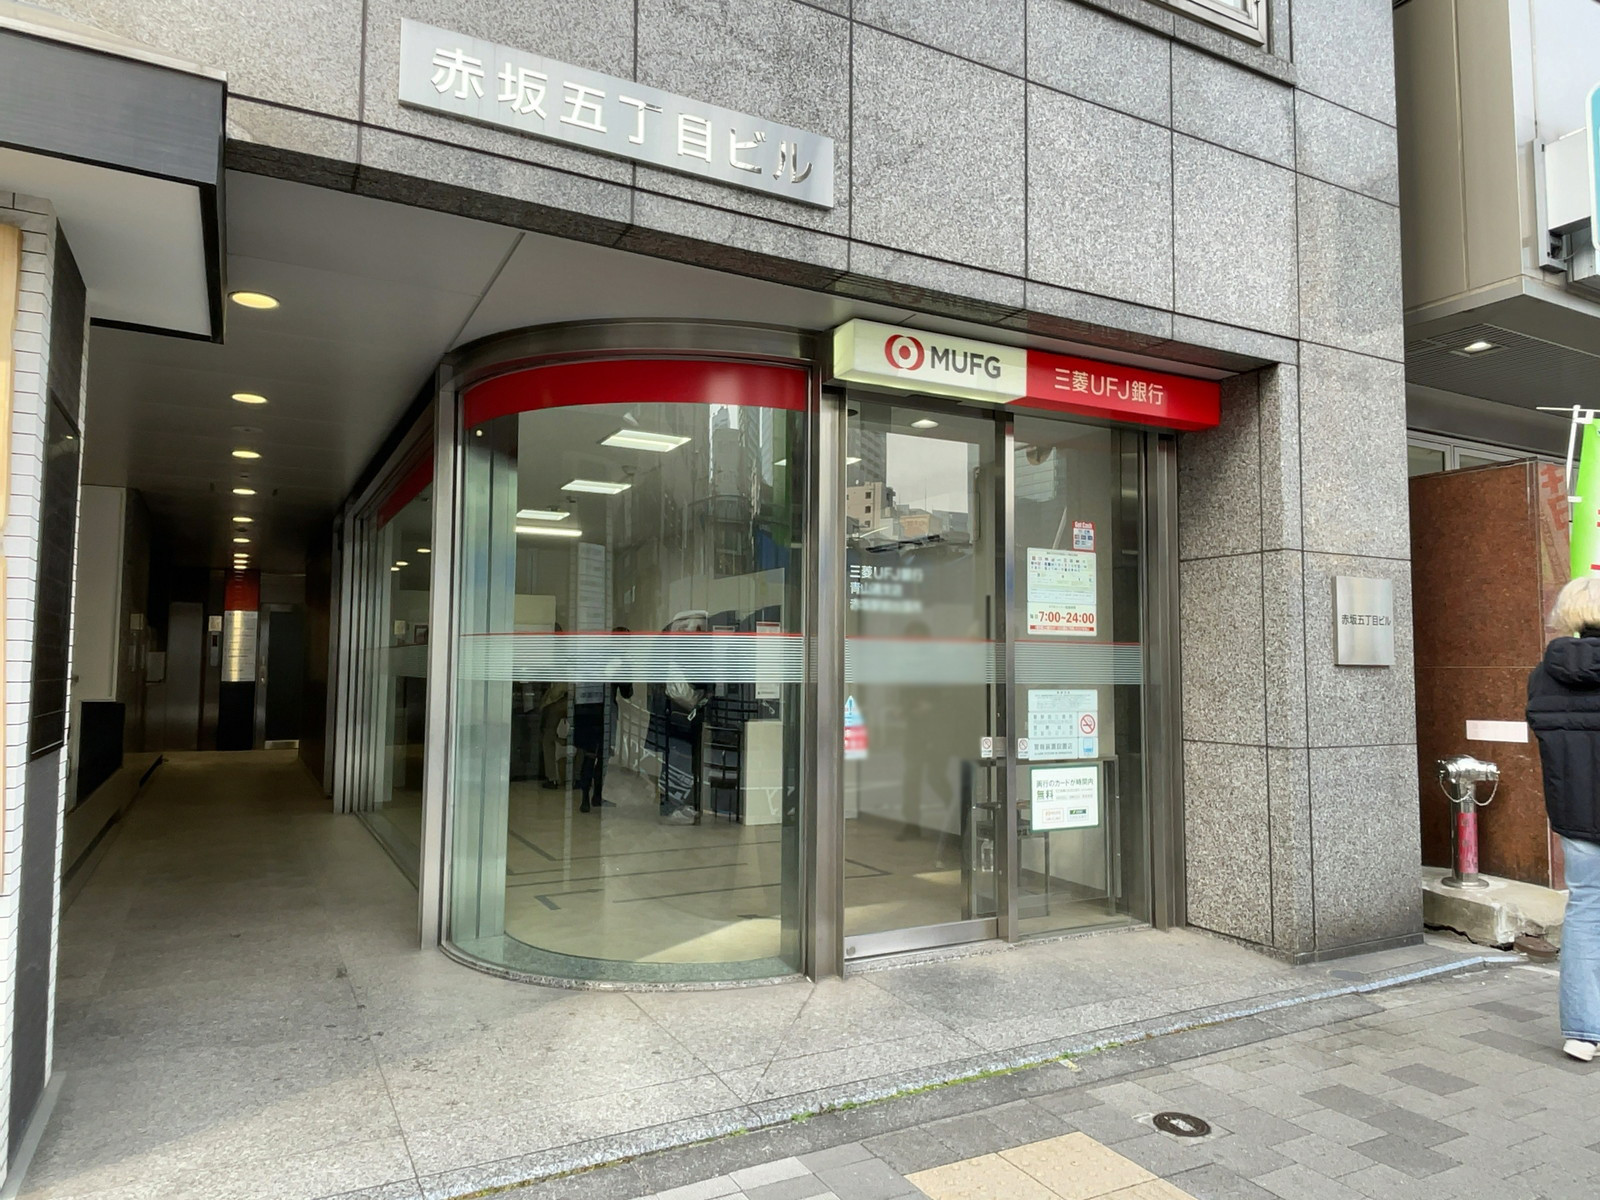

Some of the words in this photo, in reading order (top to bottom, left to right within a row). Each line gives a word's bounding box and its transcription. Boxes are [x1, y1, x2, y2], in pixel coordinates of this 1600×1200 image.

[430, 47, 813, 184] 赤坂五丁目ビル
[930, 345, 1001, 379] MUFG
[1054, 367, 1164, 405] 三菱UFJ銀行
[849, 565, 923, 582] 三菱UFJ
[1341, 614, 1392, 626] 赤坂五丁目ビル
